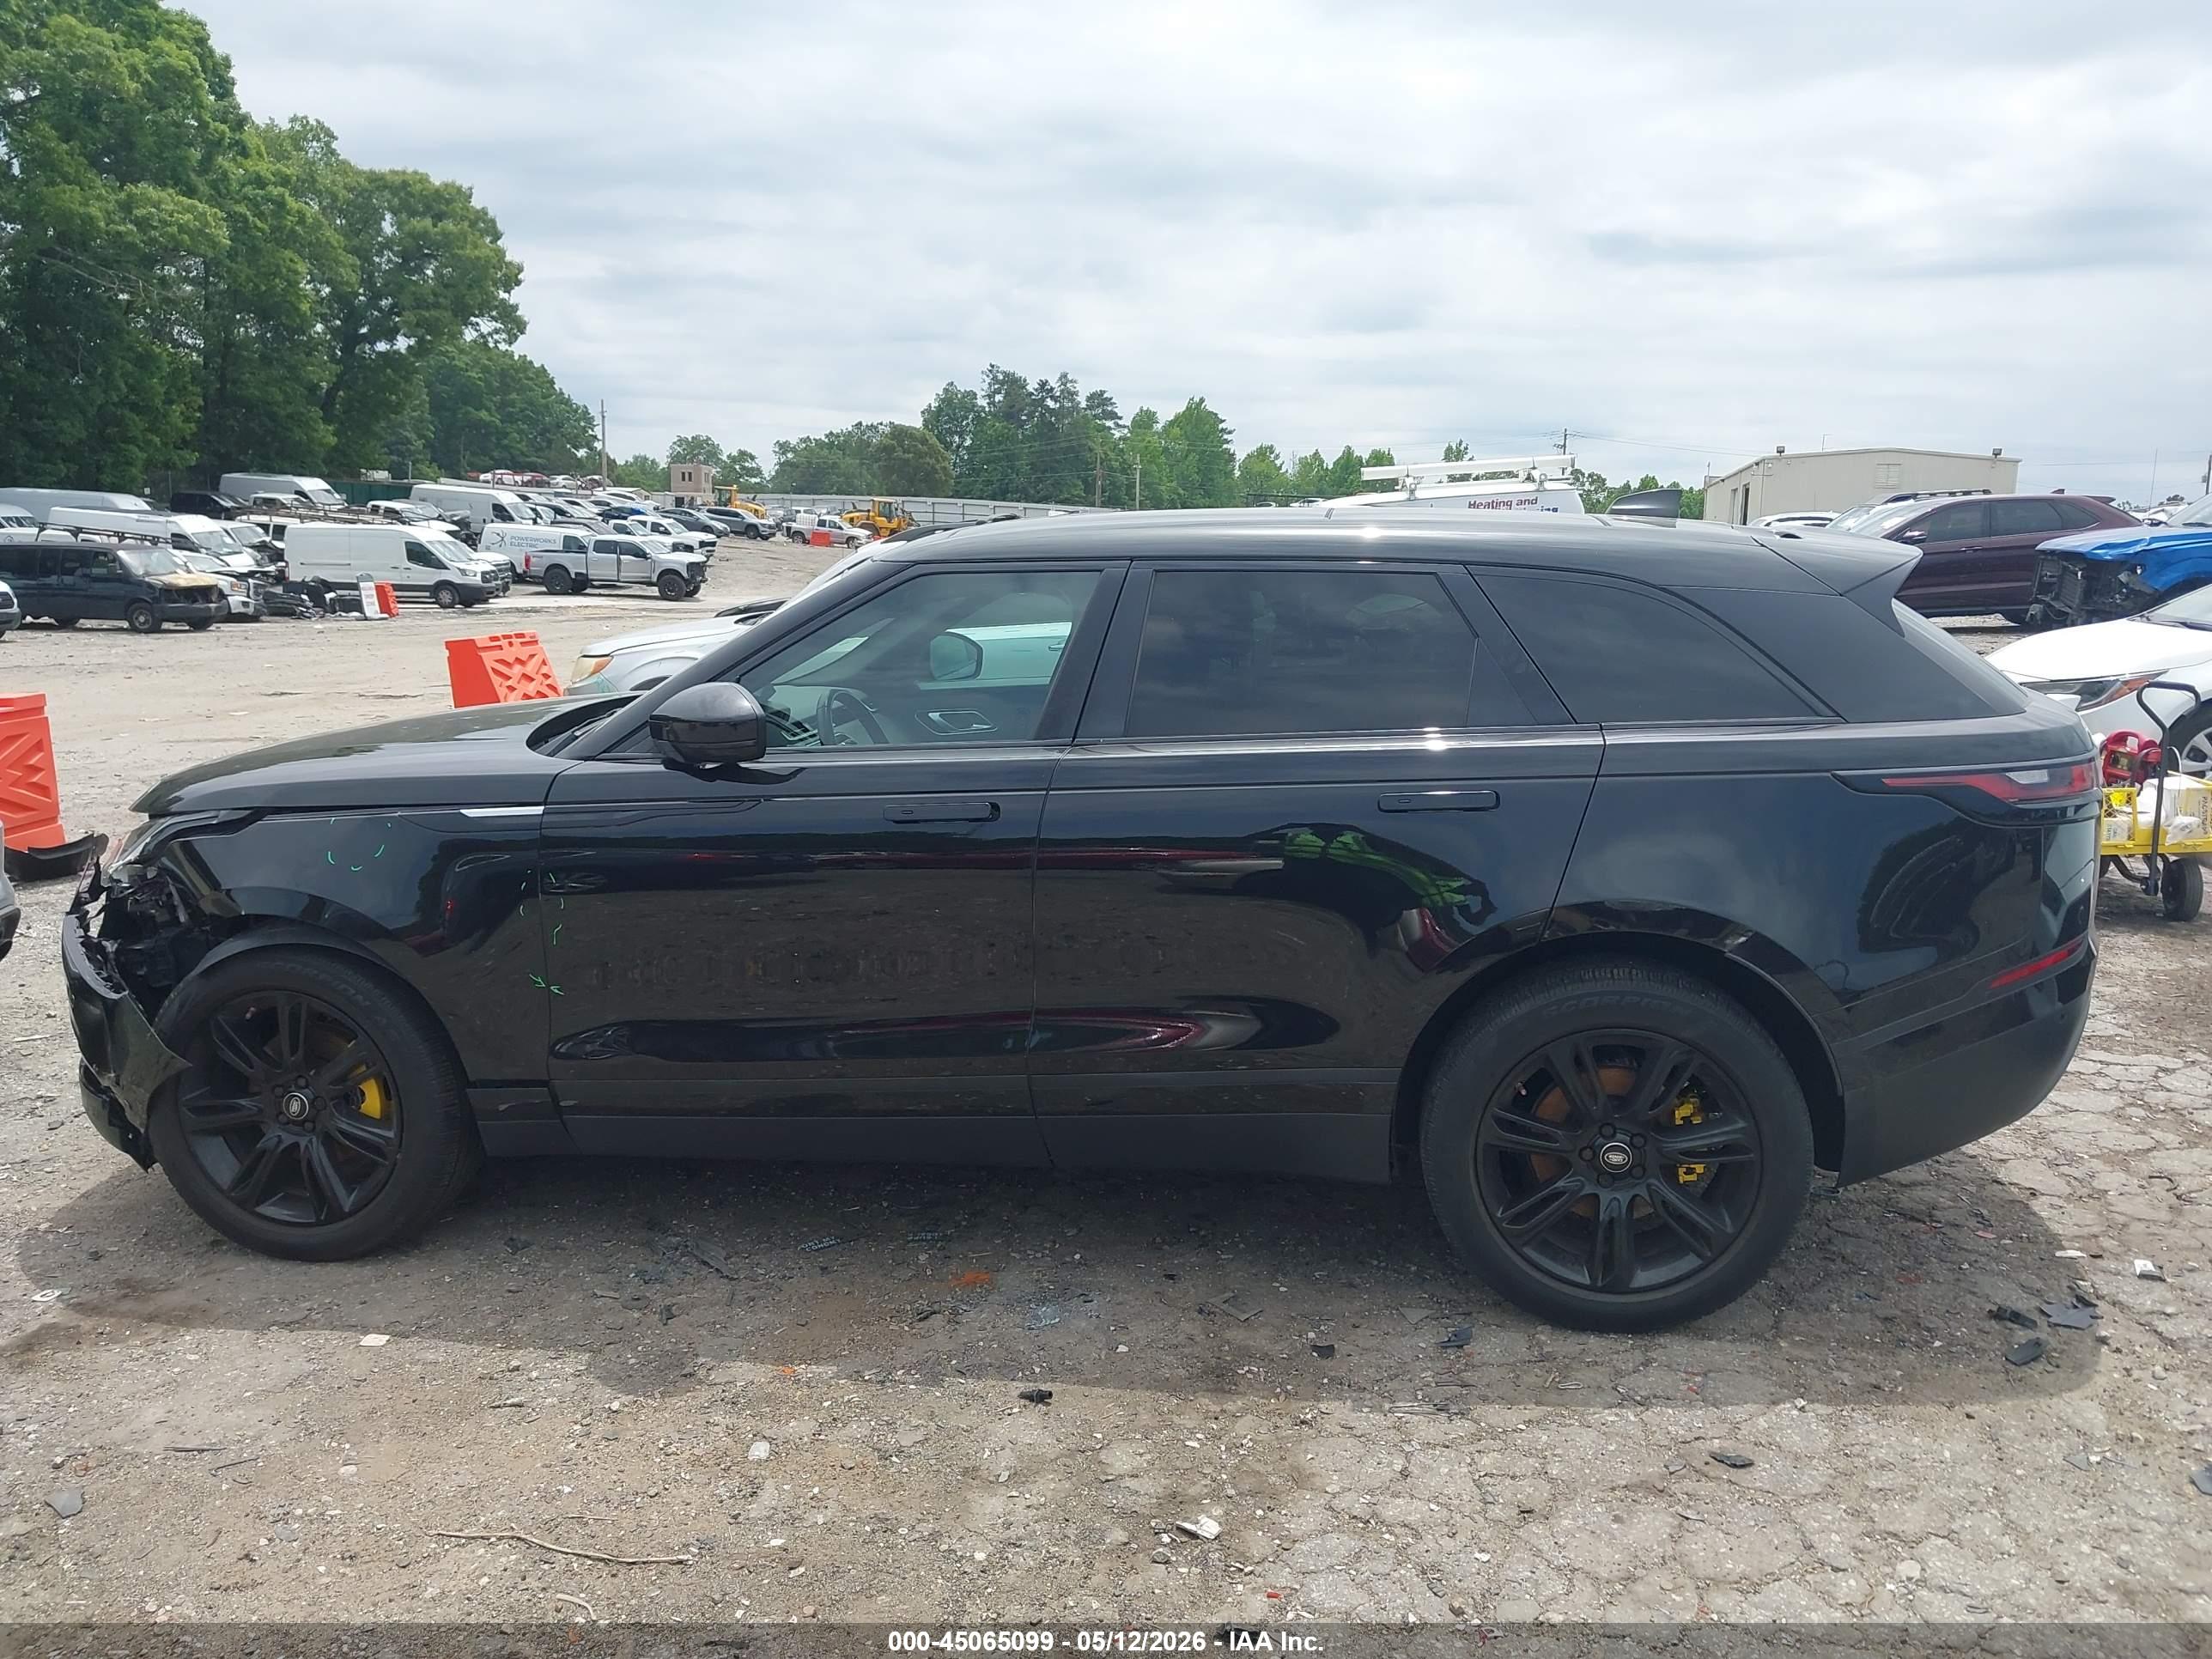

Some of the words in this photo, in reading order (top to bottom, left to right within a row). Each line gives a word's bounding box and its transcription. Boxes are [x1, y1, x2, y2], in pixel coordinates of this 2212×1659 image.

[1468, 498, 1513, 510] Heating
[1516, 496, 1539, 507] and
[509, 535, 556, 544] POWERWORKS
